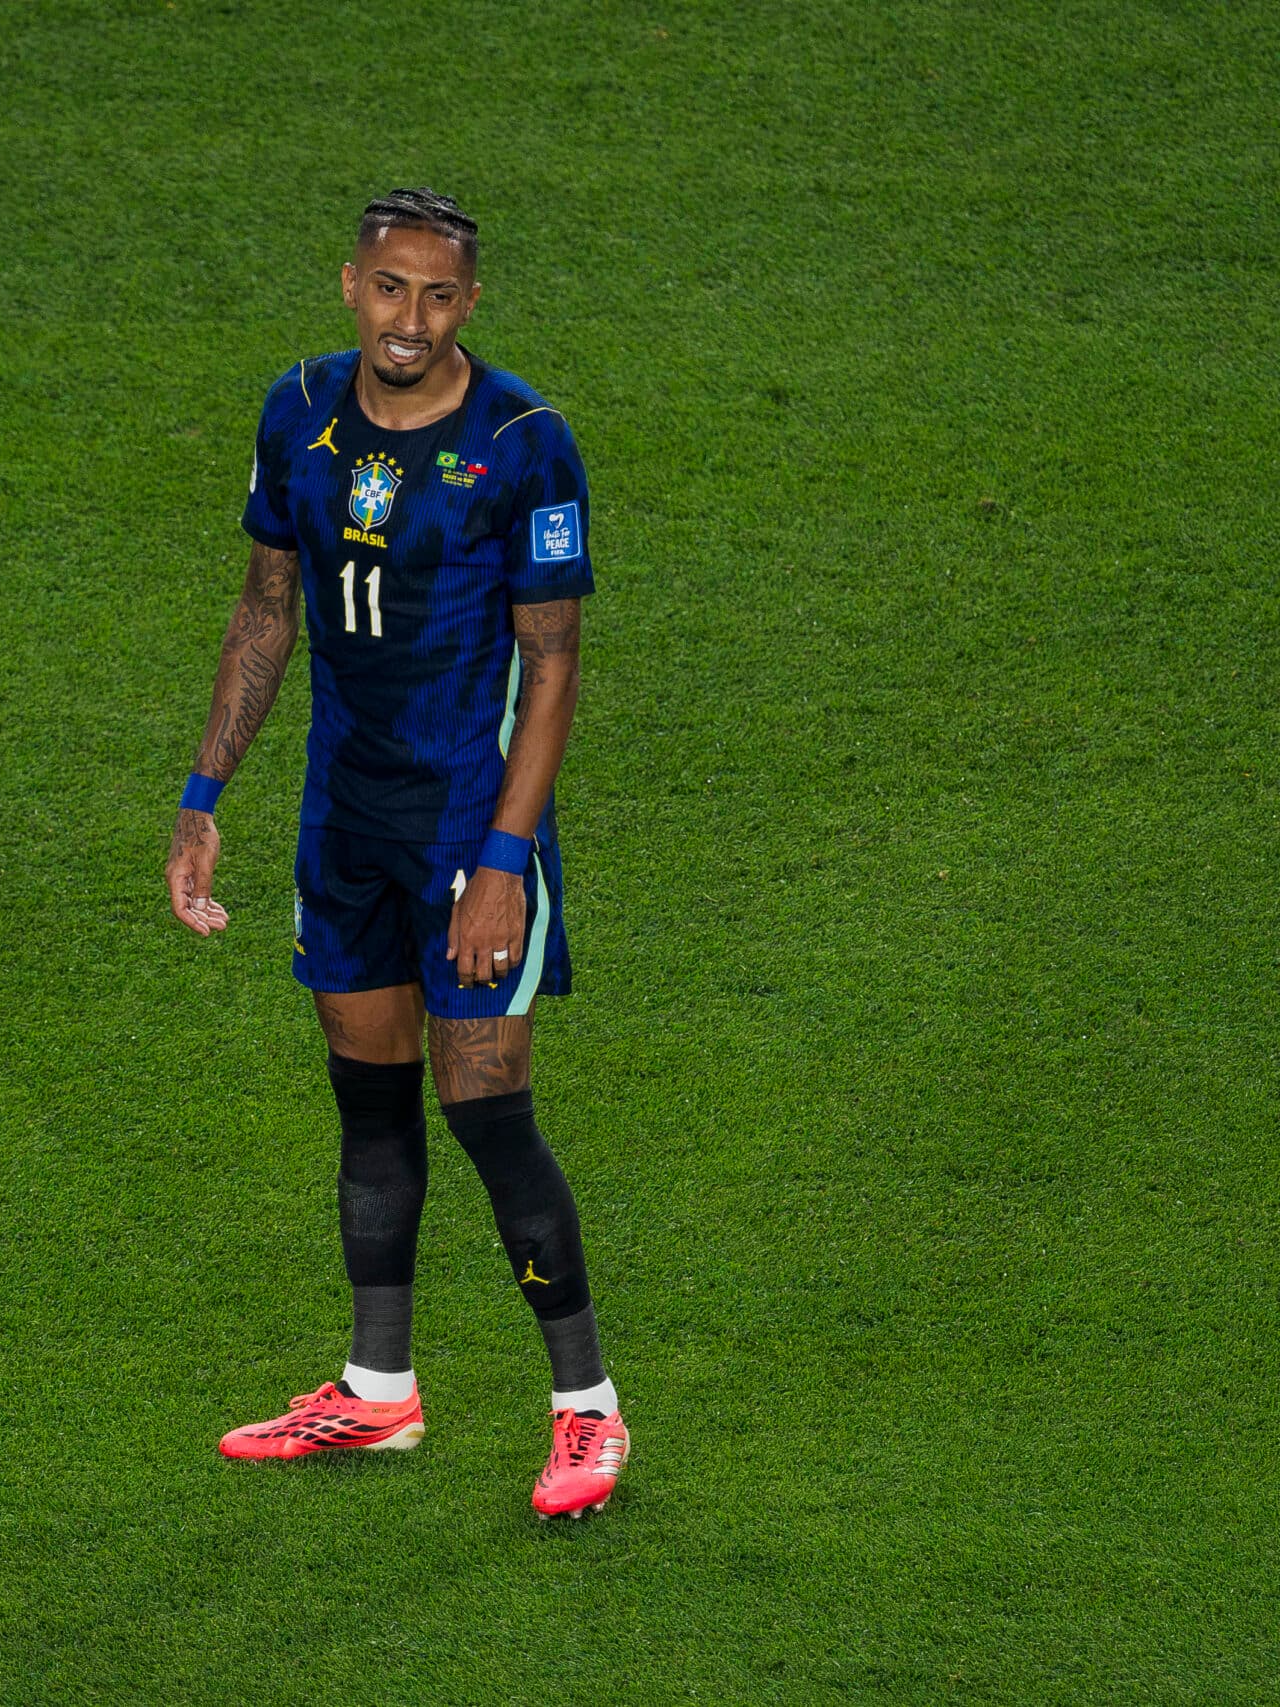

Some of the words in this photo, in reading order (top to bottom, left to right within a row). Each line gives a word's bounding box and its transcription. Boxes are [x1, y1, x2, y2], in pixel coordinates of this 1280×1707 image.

[364, 488, 382, 499] CBF
[343, 527, 388, 548] BRASIL
[546, 538, 570, 550] PEACE
[339, 560, 382, 637] 11
